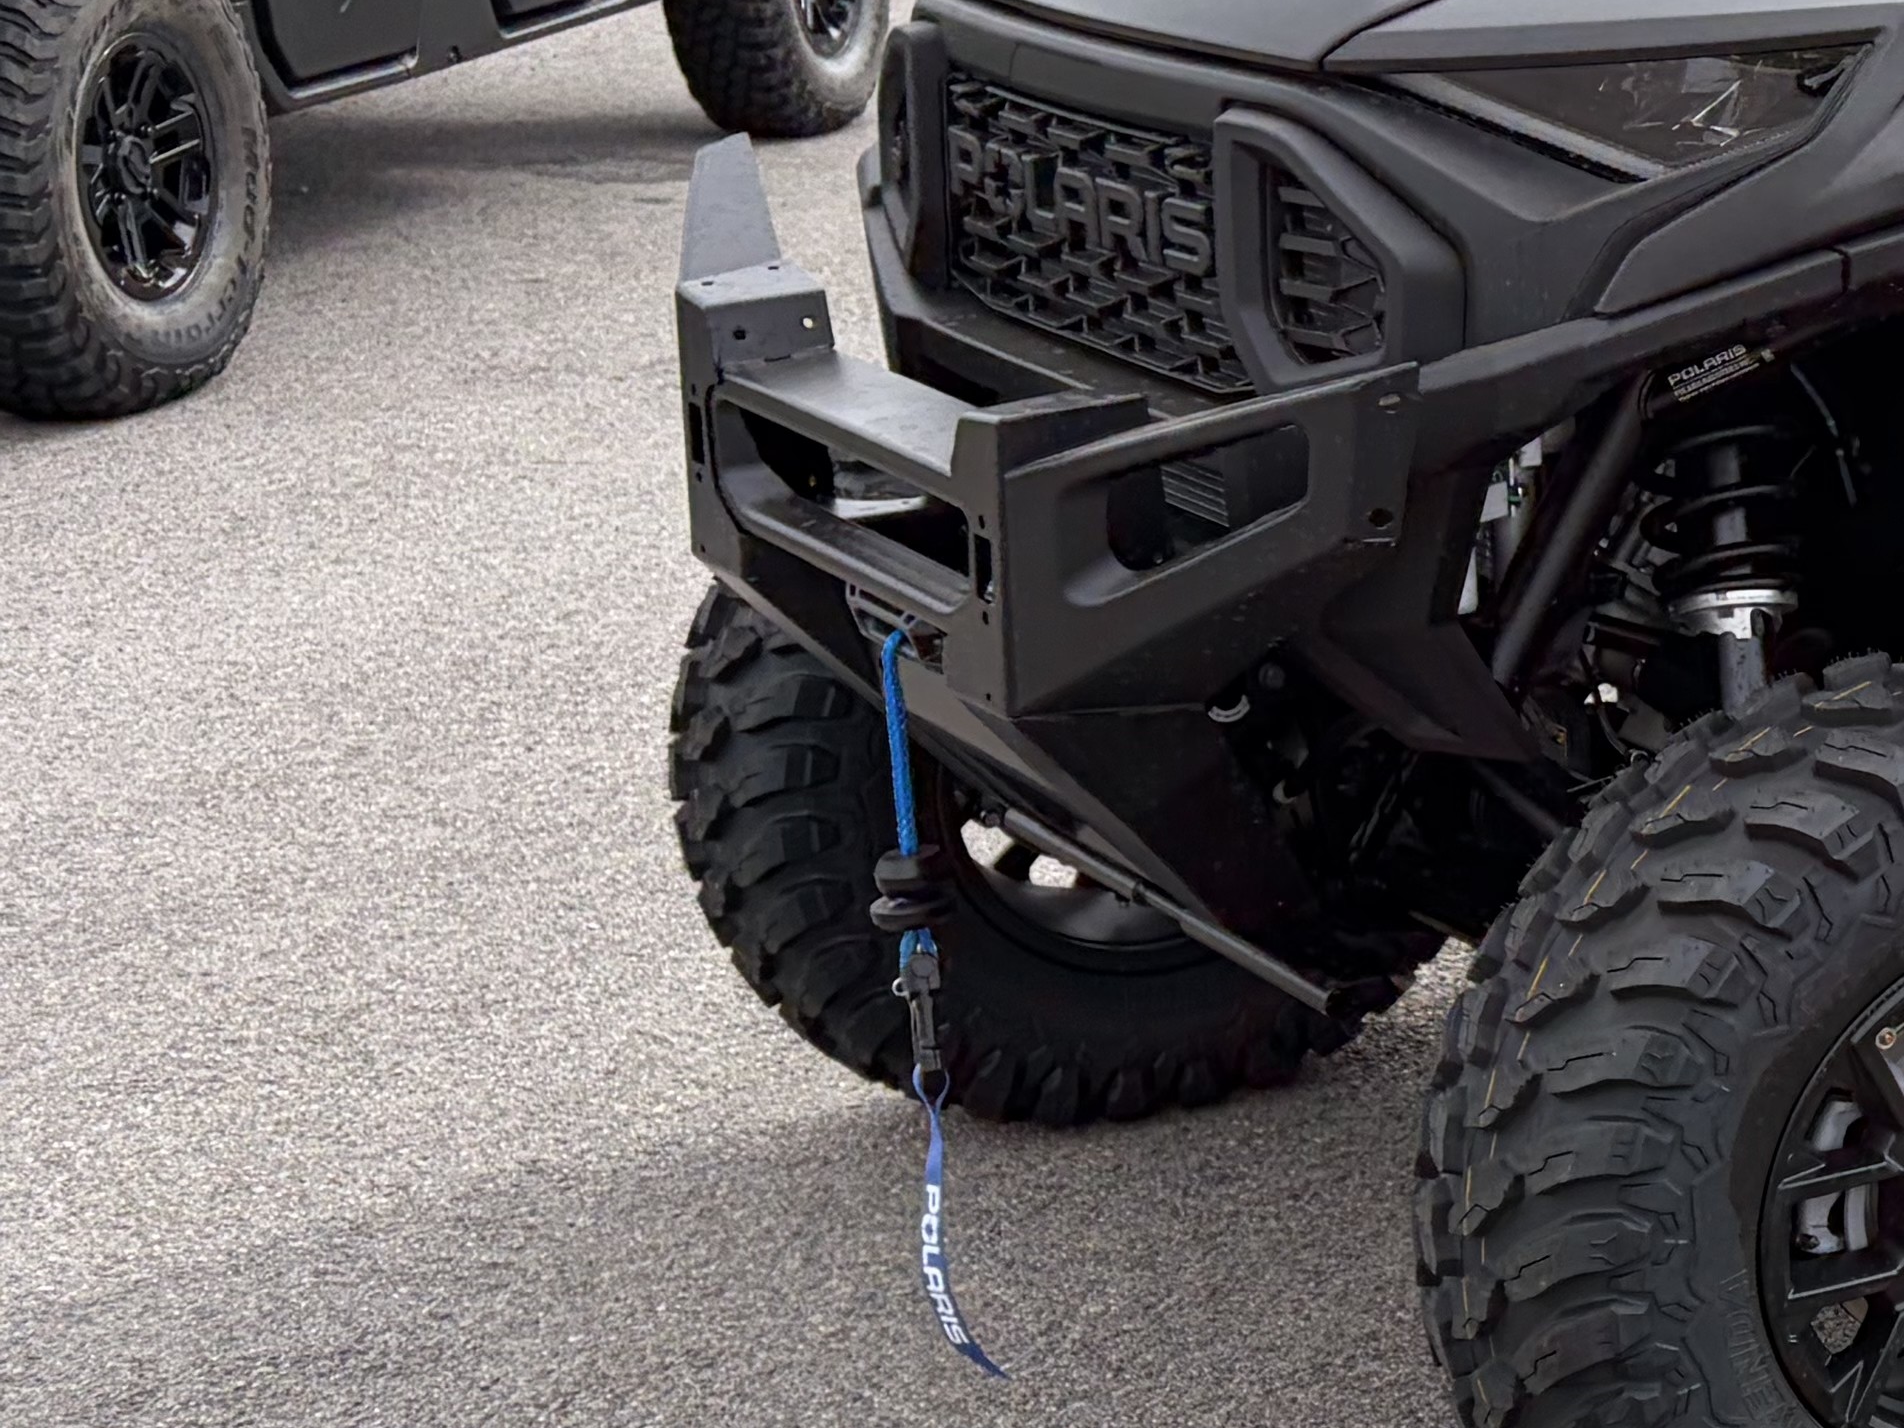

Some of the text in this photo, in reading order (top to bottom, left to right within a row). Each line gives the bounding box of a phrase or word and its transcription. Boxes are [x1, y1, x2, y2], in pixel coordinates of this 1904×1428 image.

[949, 125, 1212, 278] POLARIS
[1667, 344, 1747, 387] POLARIS
[921, 1184, 971, 1346] POLARIS
